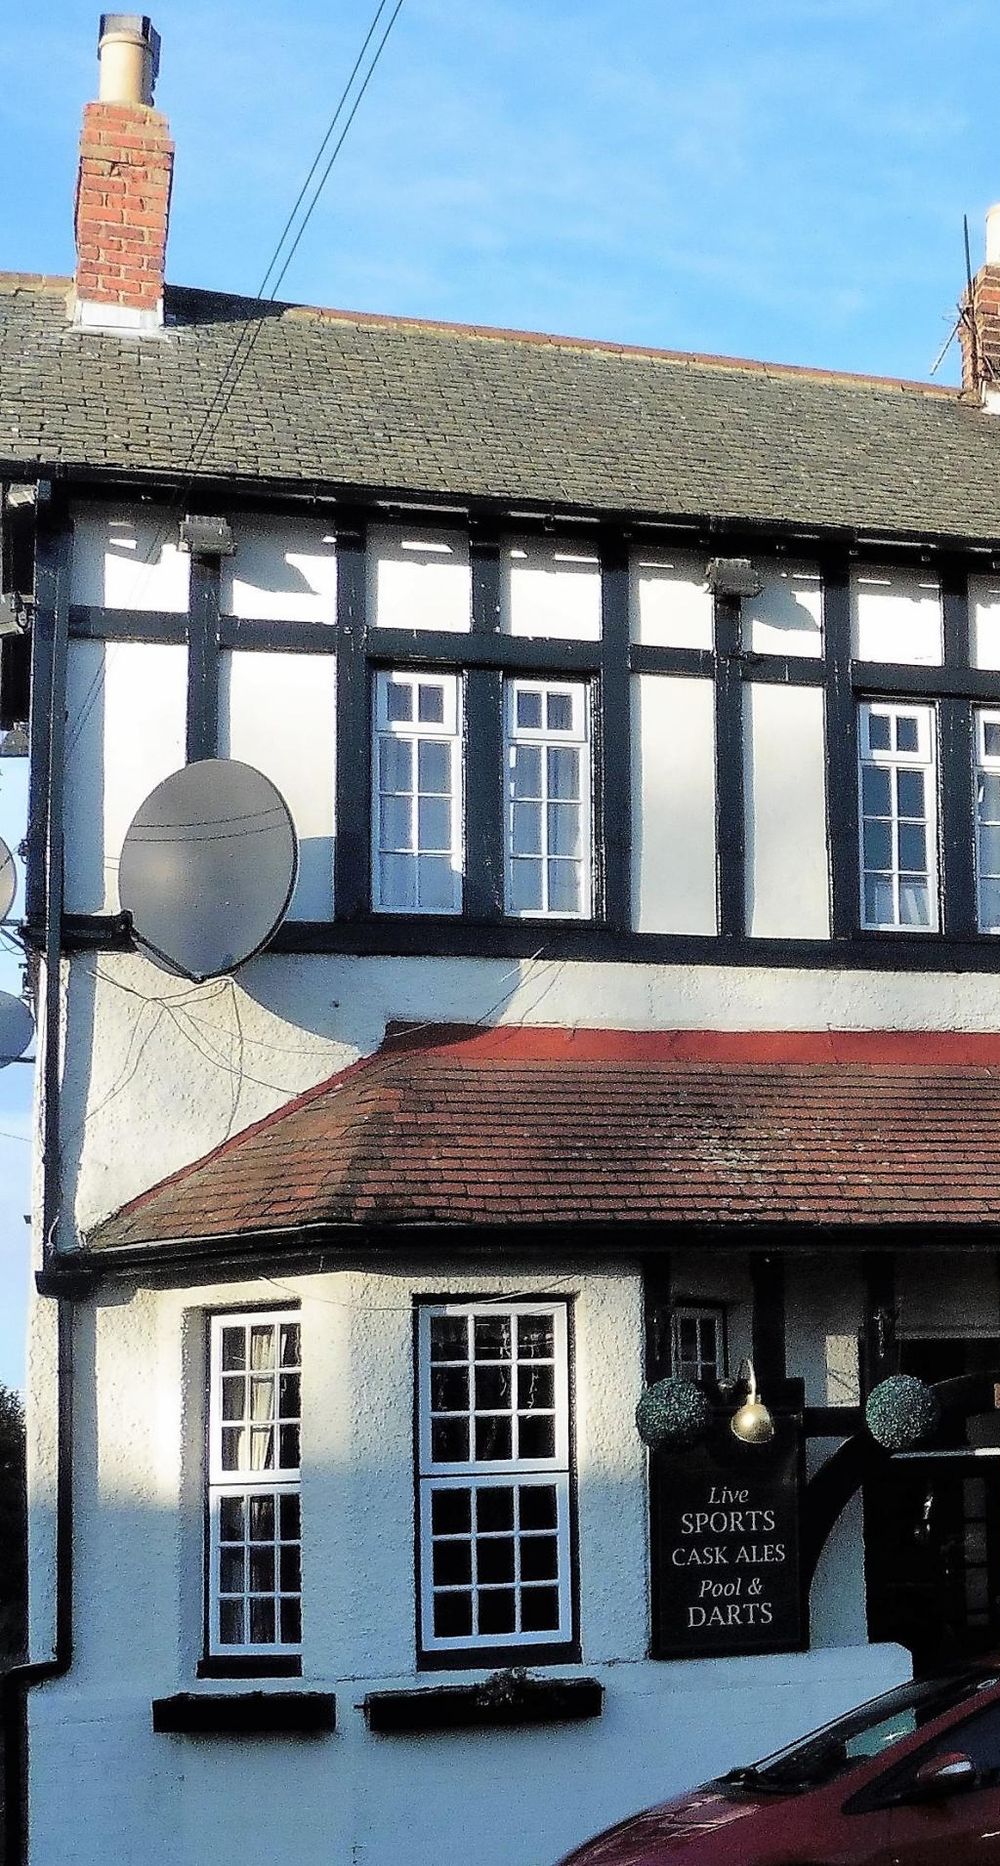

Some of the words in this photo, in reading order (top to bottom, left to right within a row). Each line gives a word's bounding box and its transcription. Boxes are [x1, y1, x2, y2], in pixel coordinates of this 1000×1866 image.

[708, 1486, 749, 1504] Live
[681, 1510, 775, 1534] SPORTS
[672, 1546, 729, 1566] CASK
[735, 1544, 786, 1564] ALES
[699, 1577, 741, 1598] Pool
[748, 1577, 763, 1595] &
[688, 1602, 773, 1628] DARTS
